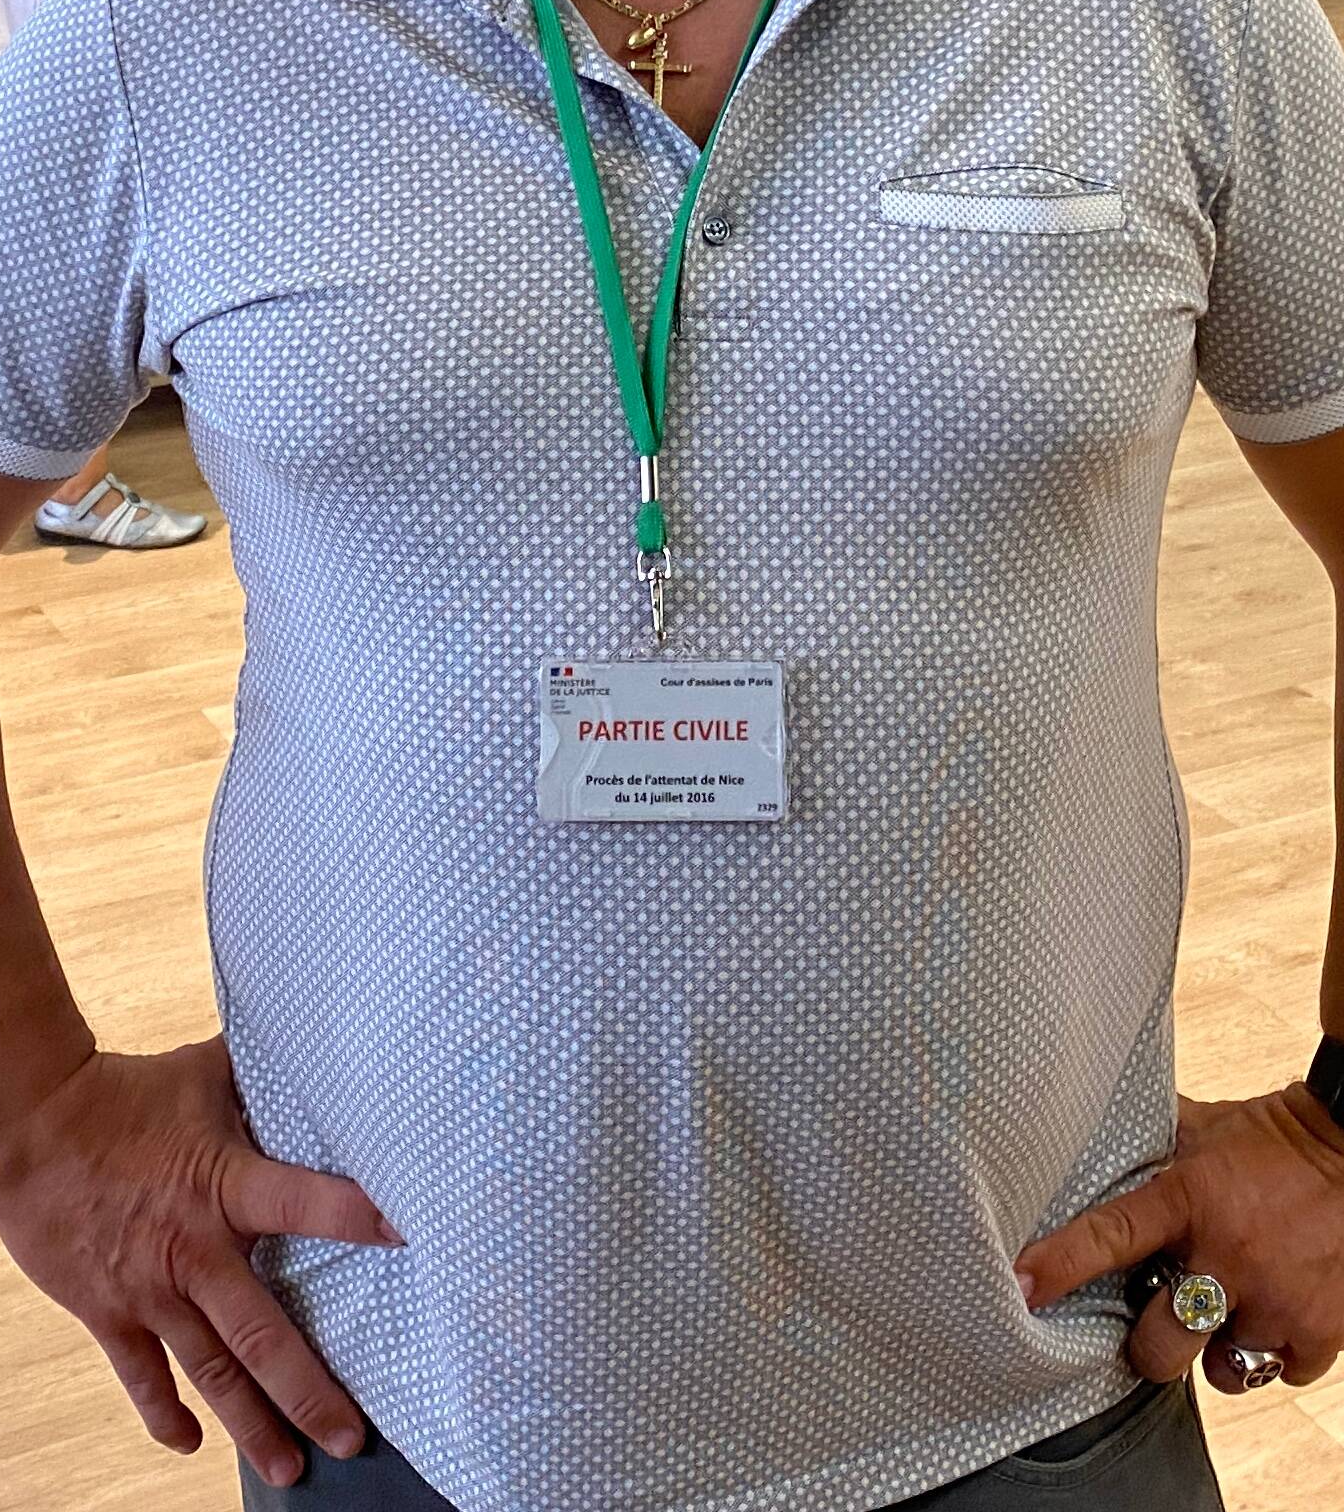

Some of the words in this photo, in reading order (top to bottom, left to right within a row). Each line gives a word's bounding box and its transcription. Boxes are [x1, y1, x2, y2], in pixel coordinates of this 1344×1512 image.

[660, 676, 685, 687] Cour
[686, 676, 732, 687] d'assises
[734, 677, 746, 687] de
[748, 677, 774, 687] Paris
[549, 688, 561, 696] DE
[563, 688, 575, 696] LA
[576, 688, 611, 697] JUSTICE
[578, 720, 665, 741] PARTIE
[673, 720, 749, 741] CIVILE
[585, 774, 625, 786] Procès
[627, 774, 642, 786] de
[644, 774, 698, 786] l'attentat
[700, 774, 716, 786] de
[718, 774, 745, 786] Nice
[614, 792, 630, 803] du
[633, 792, 648, 803] 14
[650, 792, 684, 805] juillet
[687, 792, 716, 803] 2016
